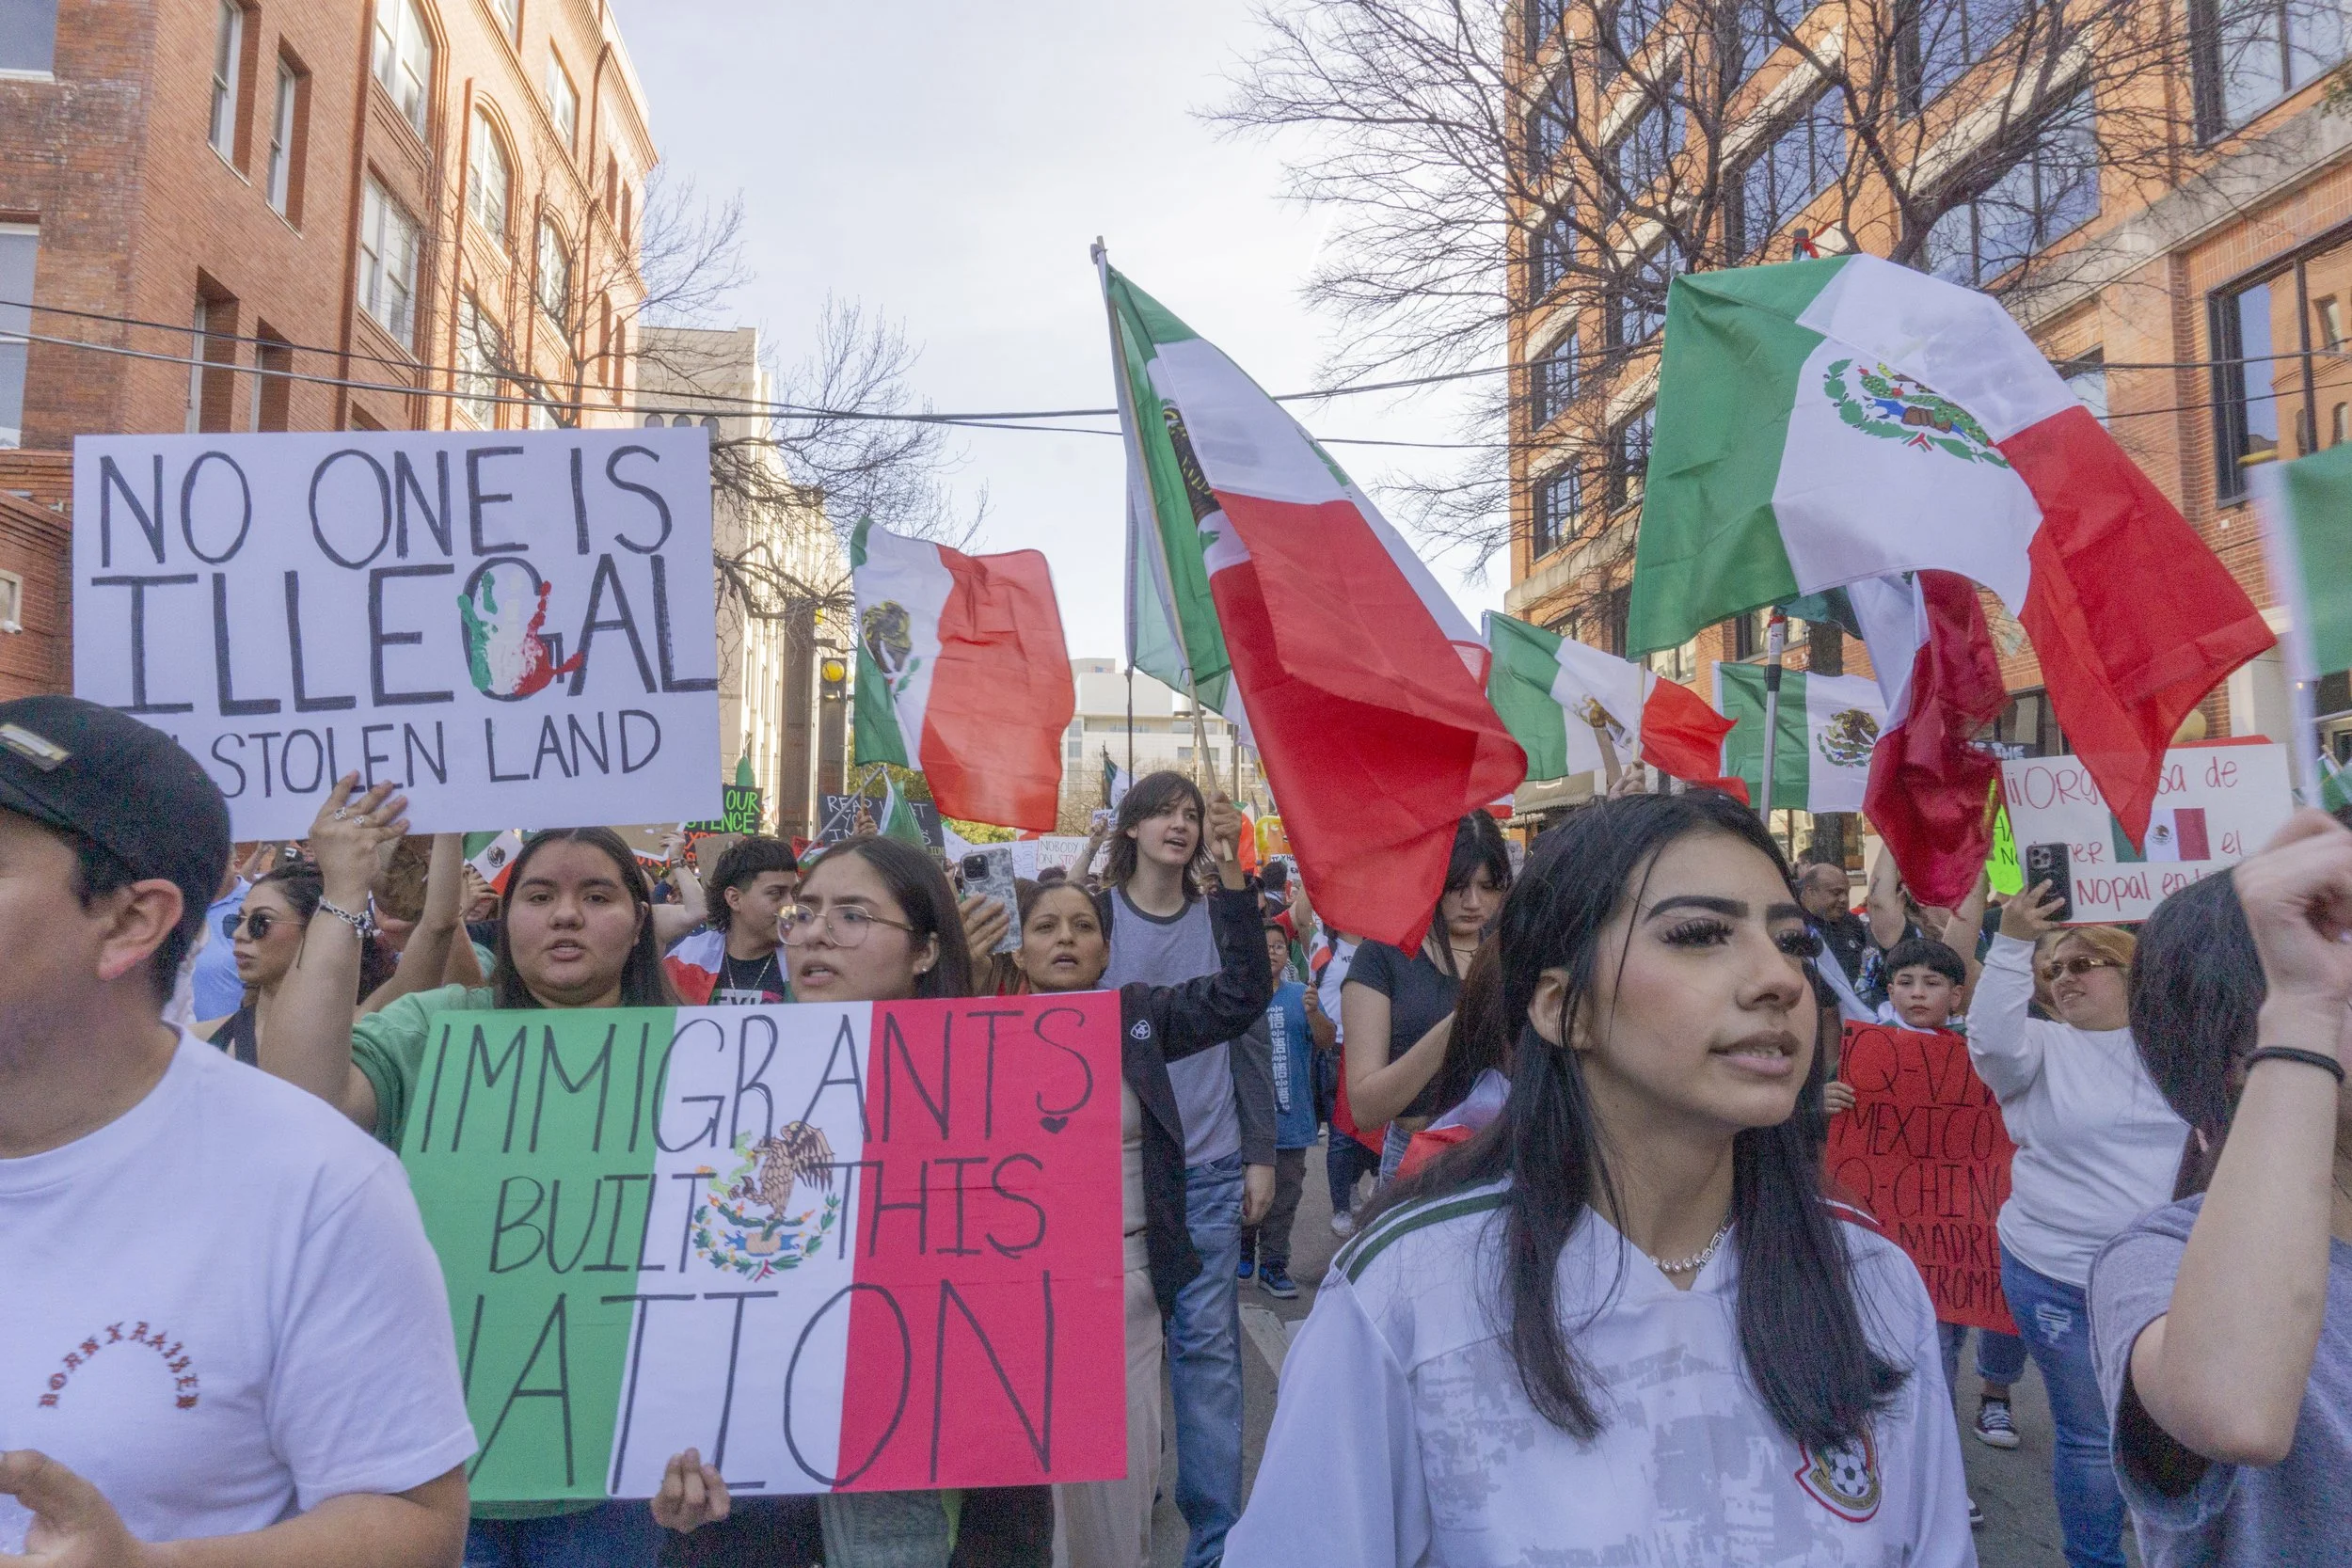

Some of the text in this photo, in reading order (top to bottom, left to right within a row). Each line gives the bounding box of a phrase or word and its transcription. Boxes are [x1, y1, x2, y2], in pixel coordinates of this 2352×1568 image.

[100, 444, 673, 570] NO ONE IS
[90, 551, 719, 718] ILLEGAL
[211, 709, 661, 799] STOLEN LAND
[2205, 756, 2238, 788] de
[725, 789, 760, 814] OUR
[1038, 853, 1053, 865] ON
[1040, 840, 1079, 854] NOBODY
[2221, 830, 2242, 856] el
[2076, 871, 2152, 911] Nopal
[421, 1006, 1093, 1153] IMMIGRANTS
[1839, 1101, 1995, 1161] MEXICO
[488, 1153, 1047, 1274] BUILT THIS
